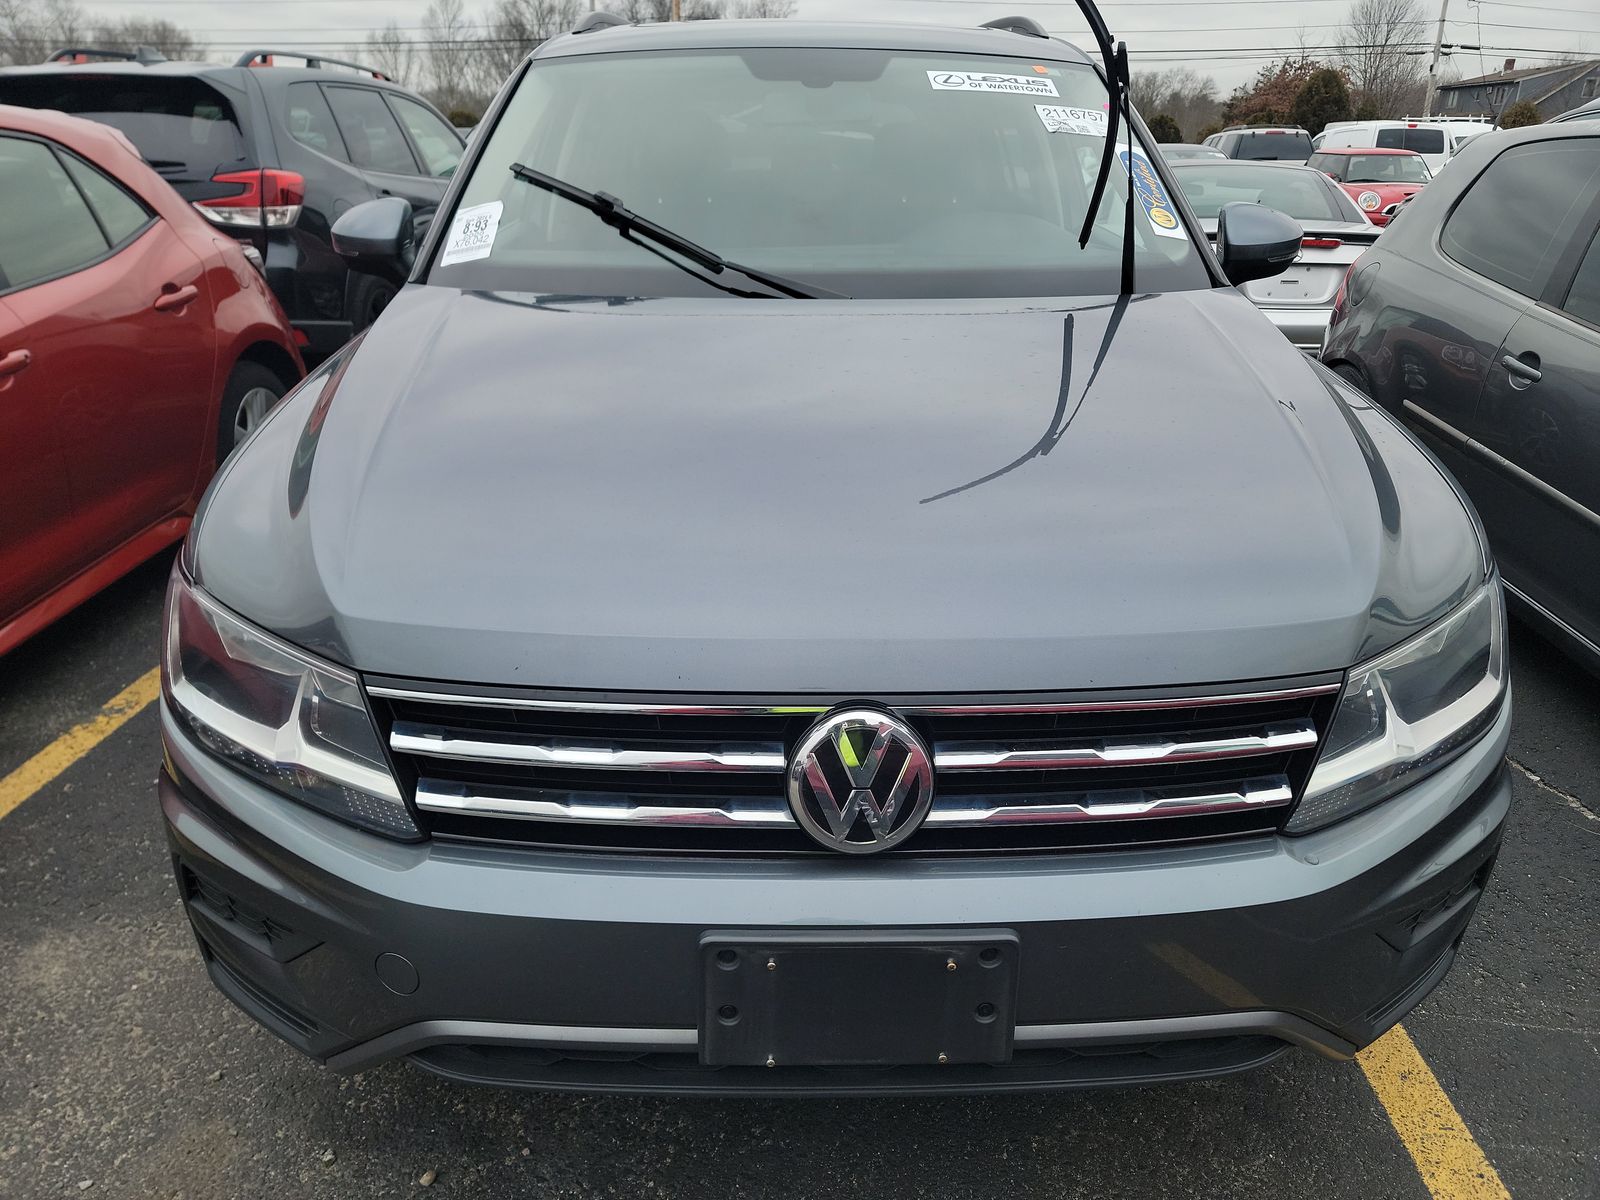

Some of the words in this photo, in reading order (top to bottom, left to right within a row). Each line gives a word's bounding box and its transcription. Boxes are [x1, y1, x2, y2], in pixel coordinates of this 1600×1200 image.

[966, 75, 1049, 87] LEXUS
[986, 83, 1053, 94] WATERTOWN
[1042, 108, 1103, 122] 2116757
